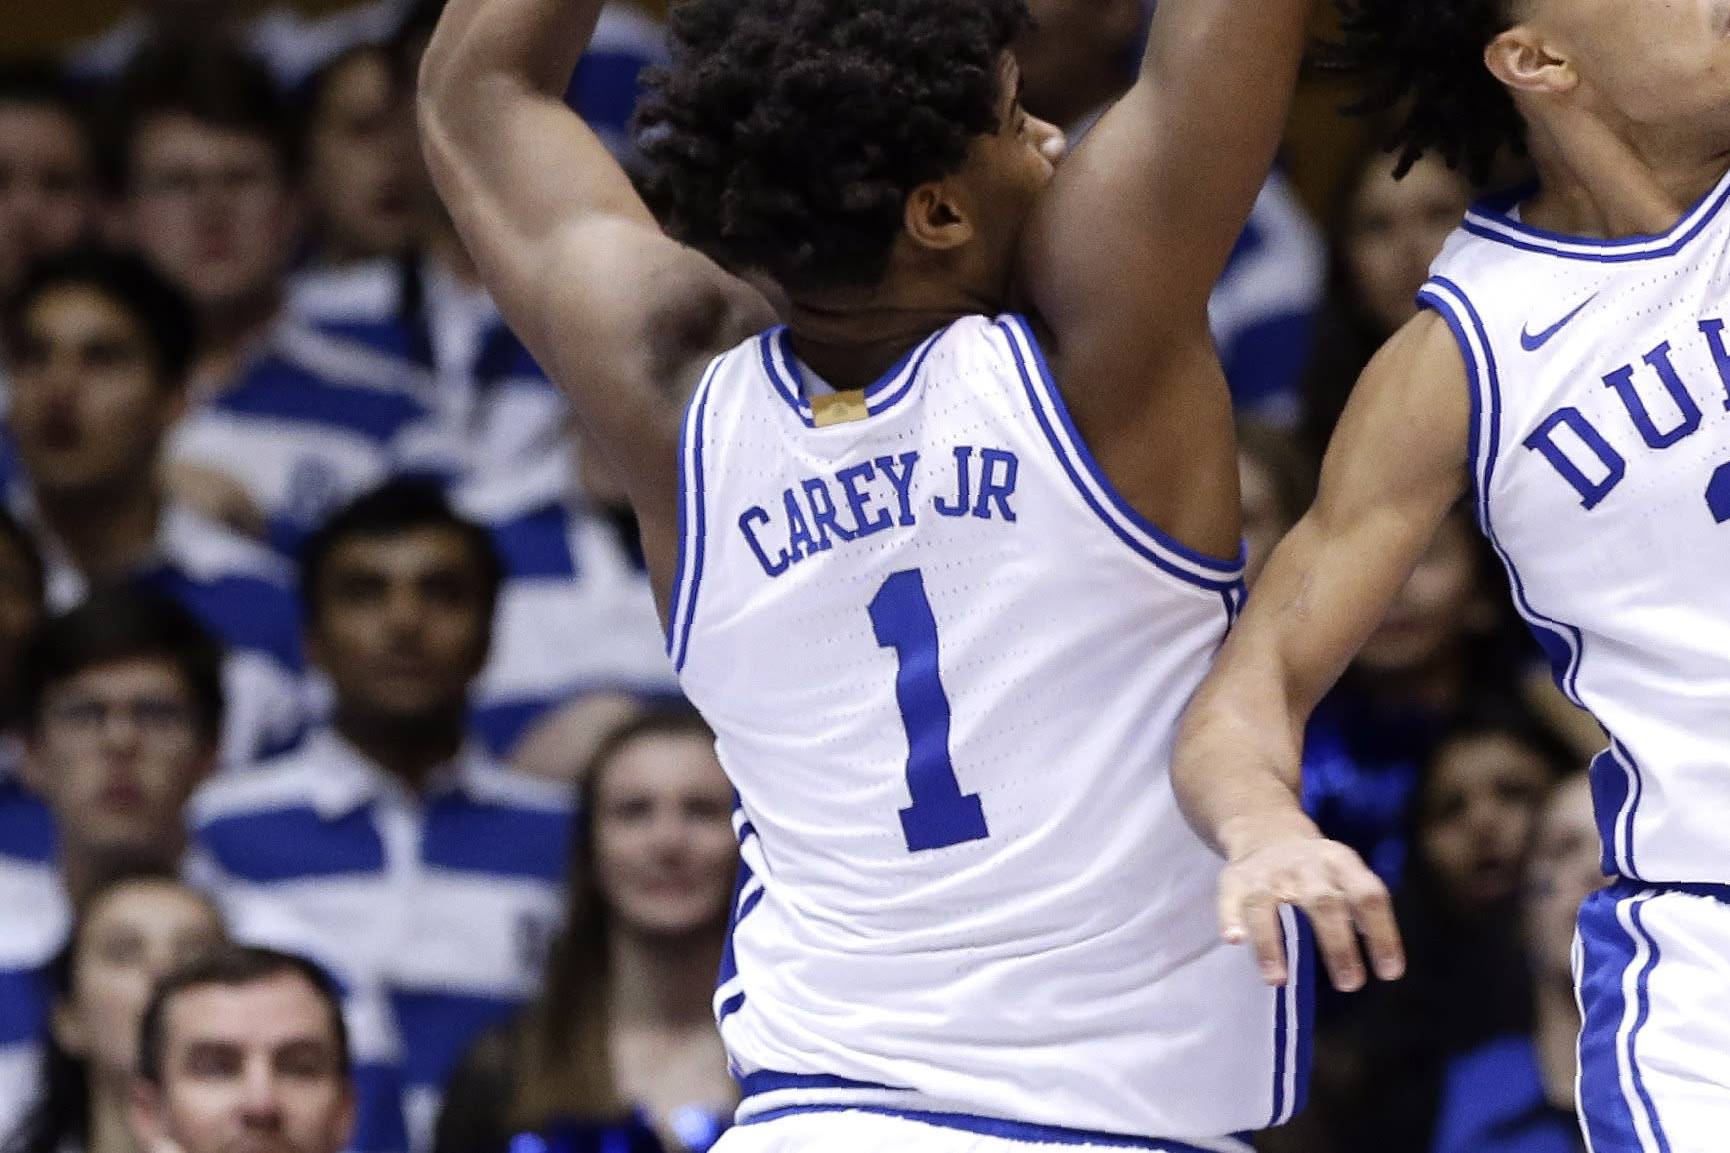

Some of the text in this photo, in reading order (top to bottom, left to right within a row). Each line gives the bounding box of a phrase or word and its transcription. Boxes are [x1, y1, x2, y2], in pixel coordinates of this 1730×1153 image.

[739, 446, 1019, 577] CAREY JR
[866, 568, 989, 853] 1
